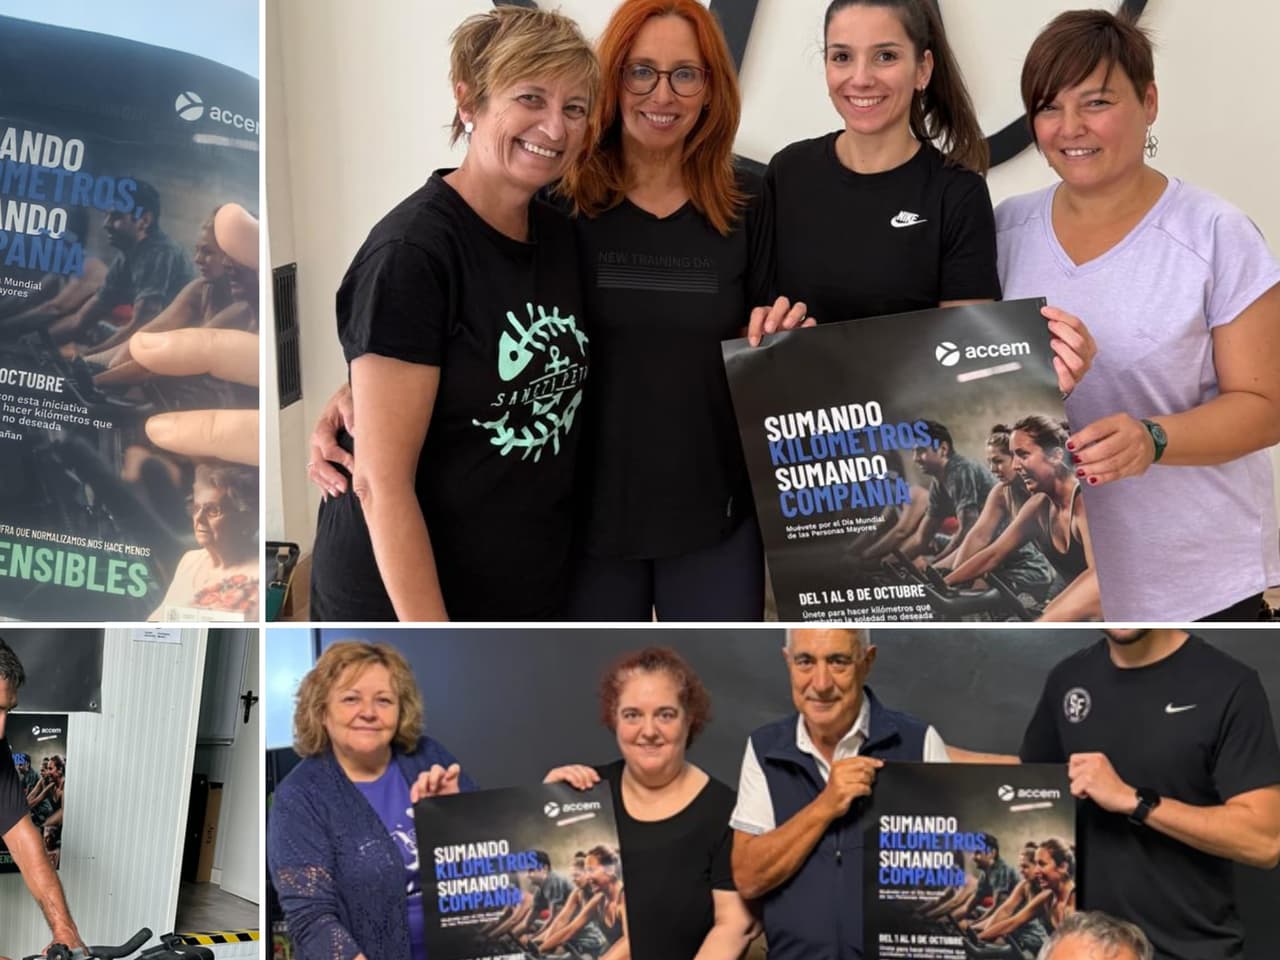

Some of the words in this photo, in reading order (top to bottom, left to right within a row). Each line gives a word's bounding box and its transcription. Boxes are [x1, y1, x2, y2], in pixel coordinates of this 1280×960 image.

[598, 251, 628, 265] NEW
[631, 253, 690, 268] TRAINING
[4, 274, 42, 291] Mundial
[965, 341, 1030, 359] accem
[17, 395, 40, 407] esta
[42, 398, 88, 415] iniciativa
[2, 414, 16, 423] no
[18, 415, 62, 431] deseada
[3, 402, 32, 416] hacer
[34, 407, 91, 426] kilómetros
[93, 419, 113, 430] que
[764, 400, 882, 443] SUMANDO
[775, 454, 888, 491] SUMANDO
[16, 526, 30, 538] QUE
[32, 529, 86, 548] NORMALIZAMOS
[87, 539, 103, 549] NOS
[104, 541, 124, 553] HACE
[125, 544, 151, 557] MENOS
[799, 592, 820, 605] DEL
[822, 591, 828, 603] 1
[831, 590, 845, 603] AL
[848, 589, 855, 601] 8
[856, 588, 872, 601] DE
[874, 584, 926, 600] OCTUBRE
[915, 604, 931, 613] que
[1017, 788, 1061, 798] accem
[562, 801, 601, 813] accem
[879, 815, 958, 833] SUMANDO
[434, 839, 509, 866] SUMANDO
[879, 851, 954, 869] SUMANDO
[437, 873, 510, 897] SUMANDO
